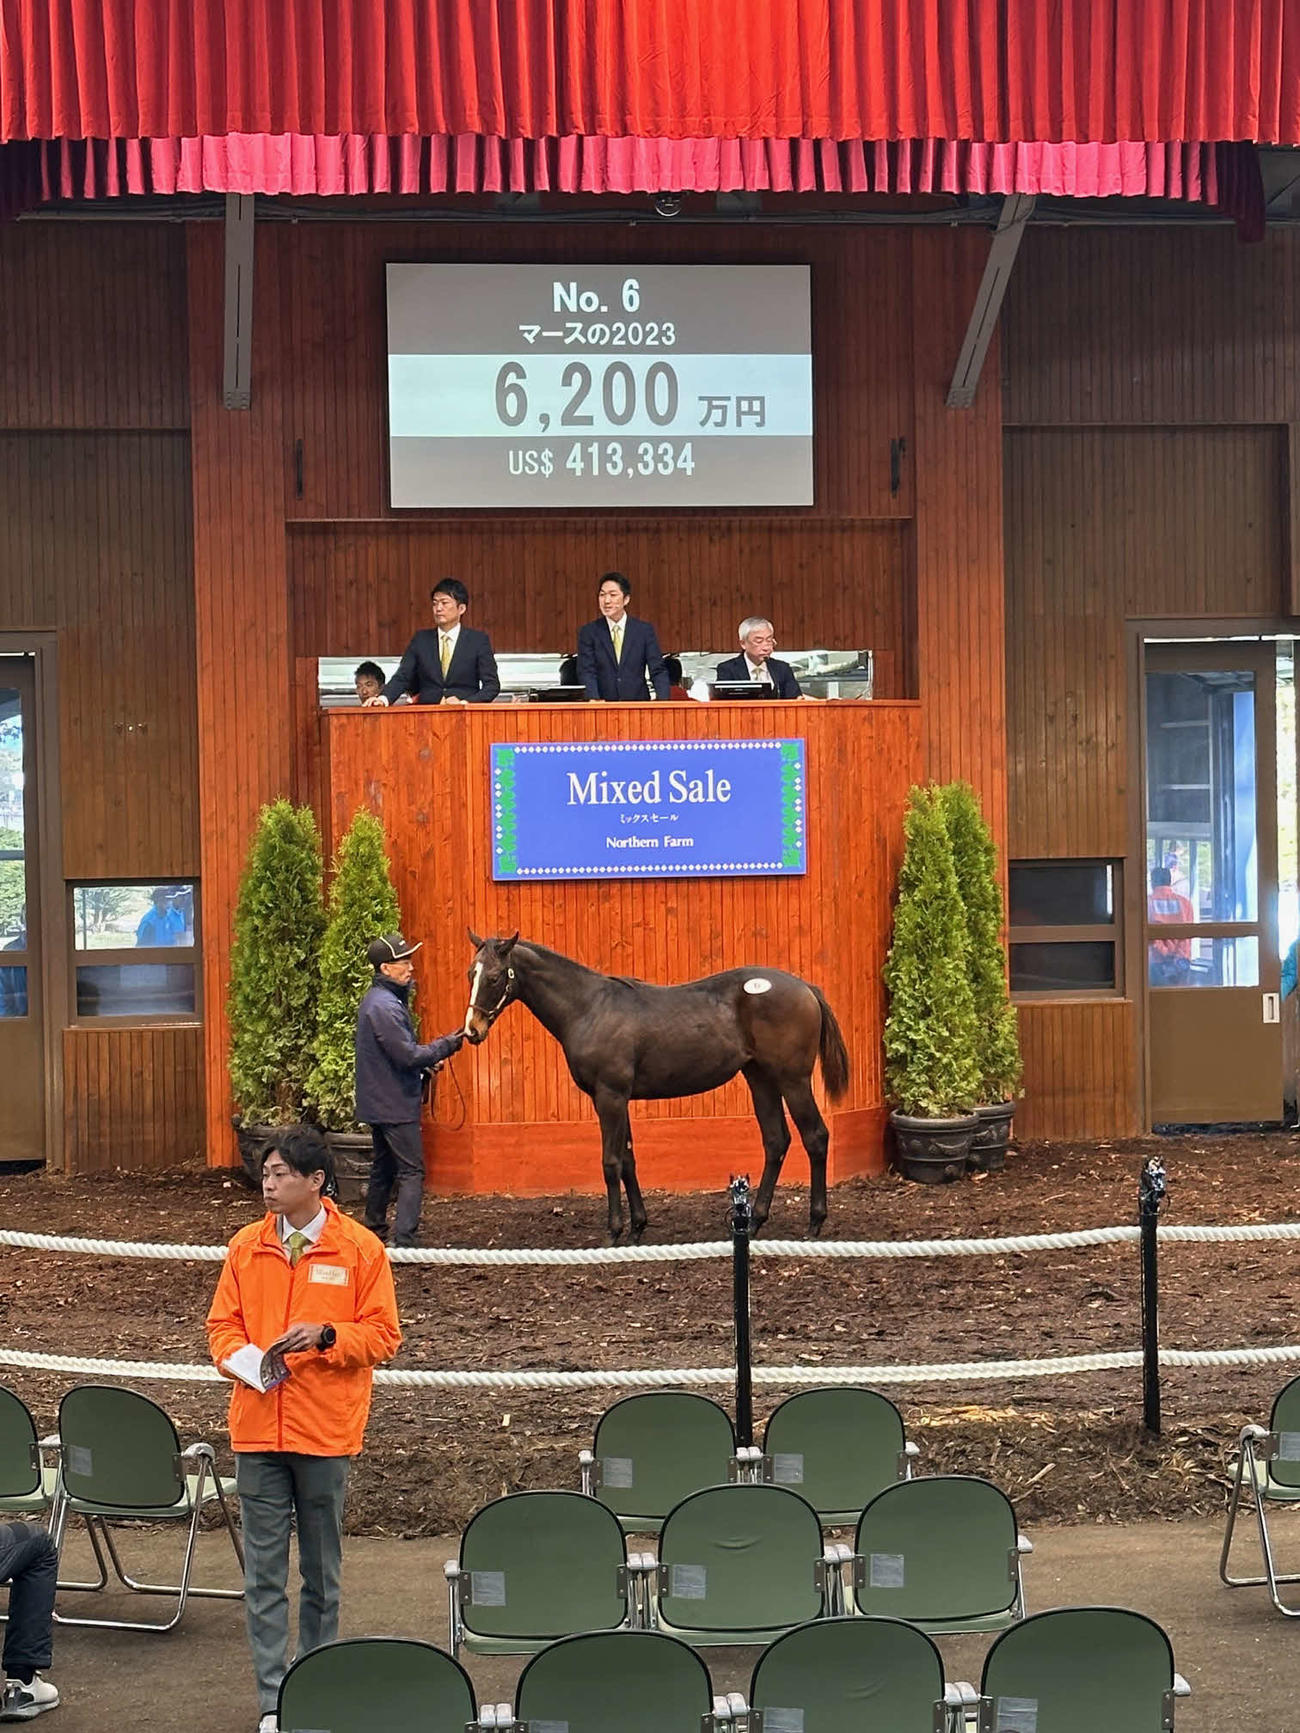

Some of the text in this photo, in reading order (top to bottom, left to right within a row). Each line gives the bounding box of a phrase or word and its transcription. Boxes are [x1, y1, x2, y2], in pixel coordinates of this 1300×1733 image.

[553, 278, 640, 312] No. 6
[518, 322, 676, 346] マースの2023
[495, 360, 766, 432] 6,200 万円
[508, 442, 695, 478] US$ 413,334
[567, 769, 732, 805] Mixed Sale
[620, 813, 679, 824] ミックスセール
[606, 835, 694, 848] Northern Farm
